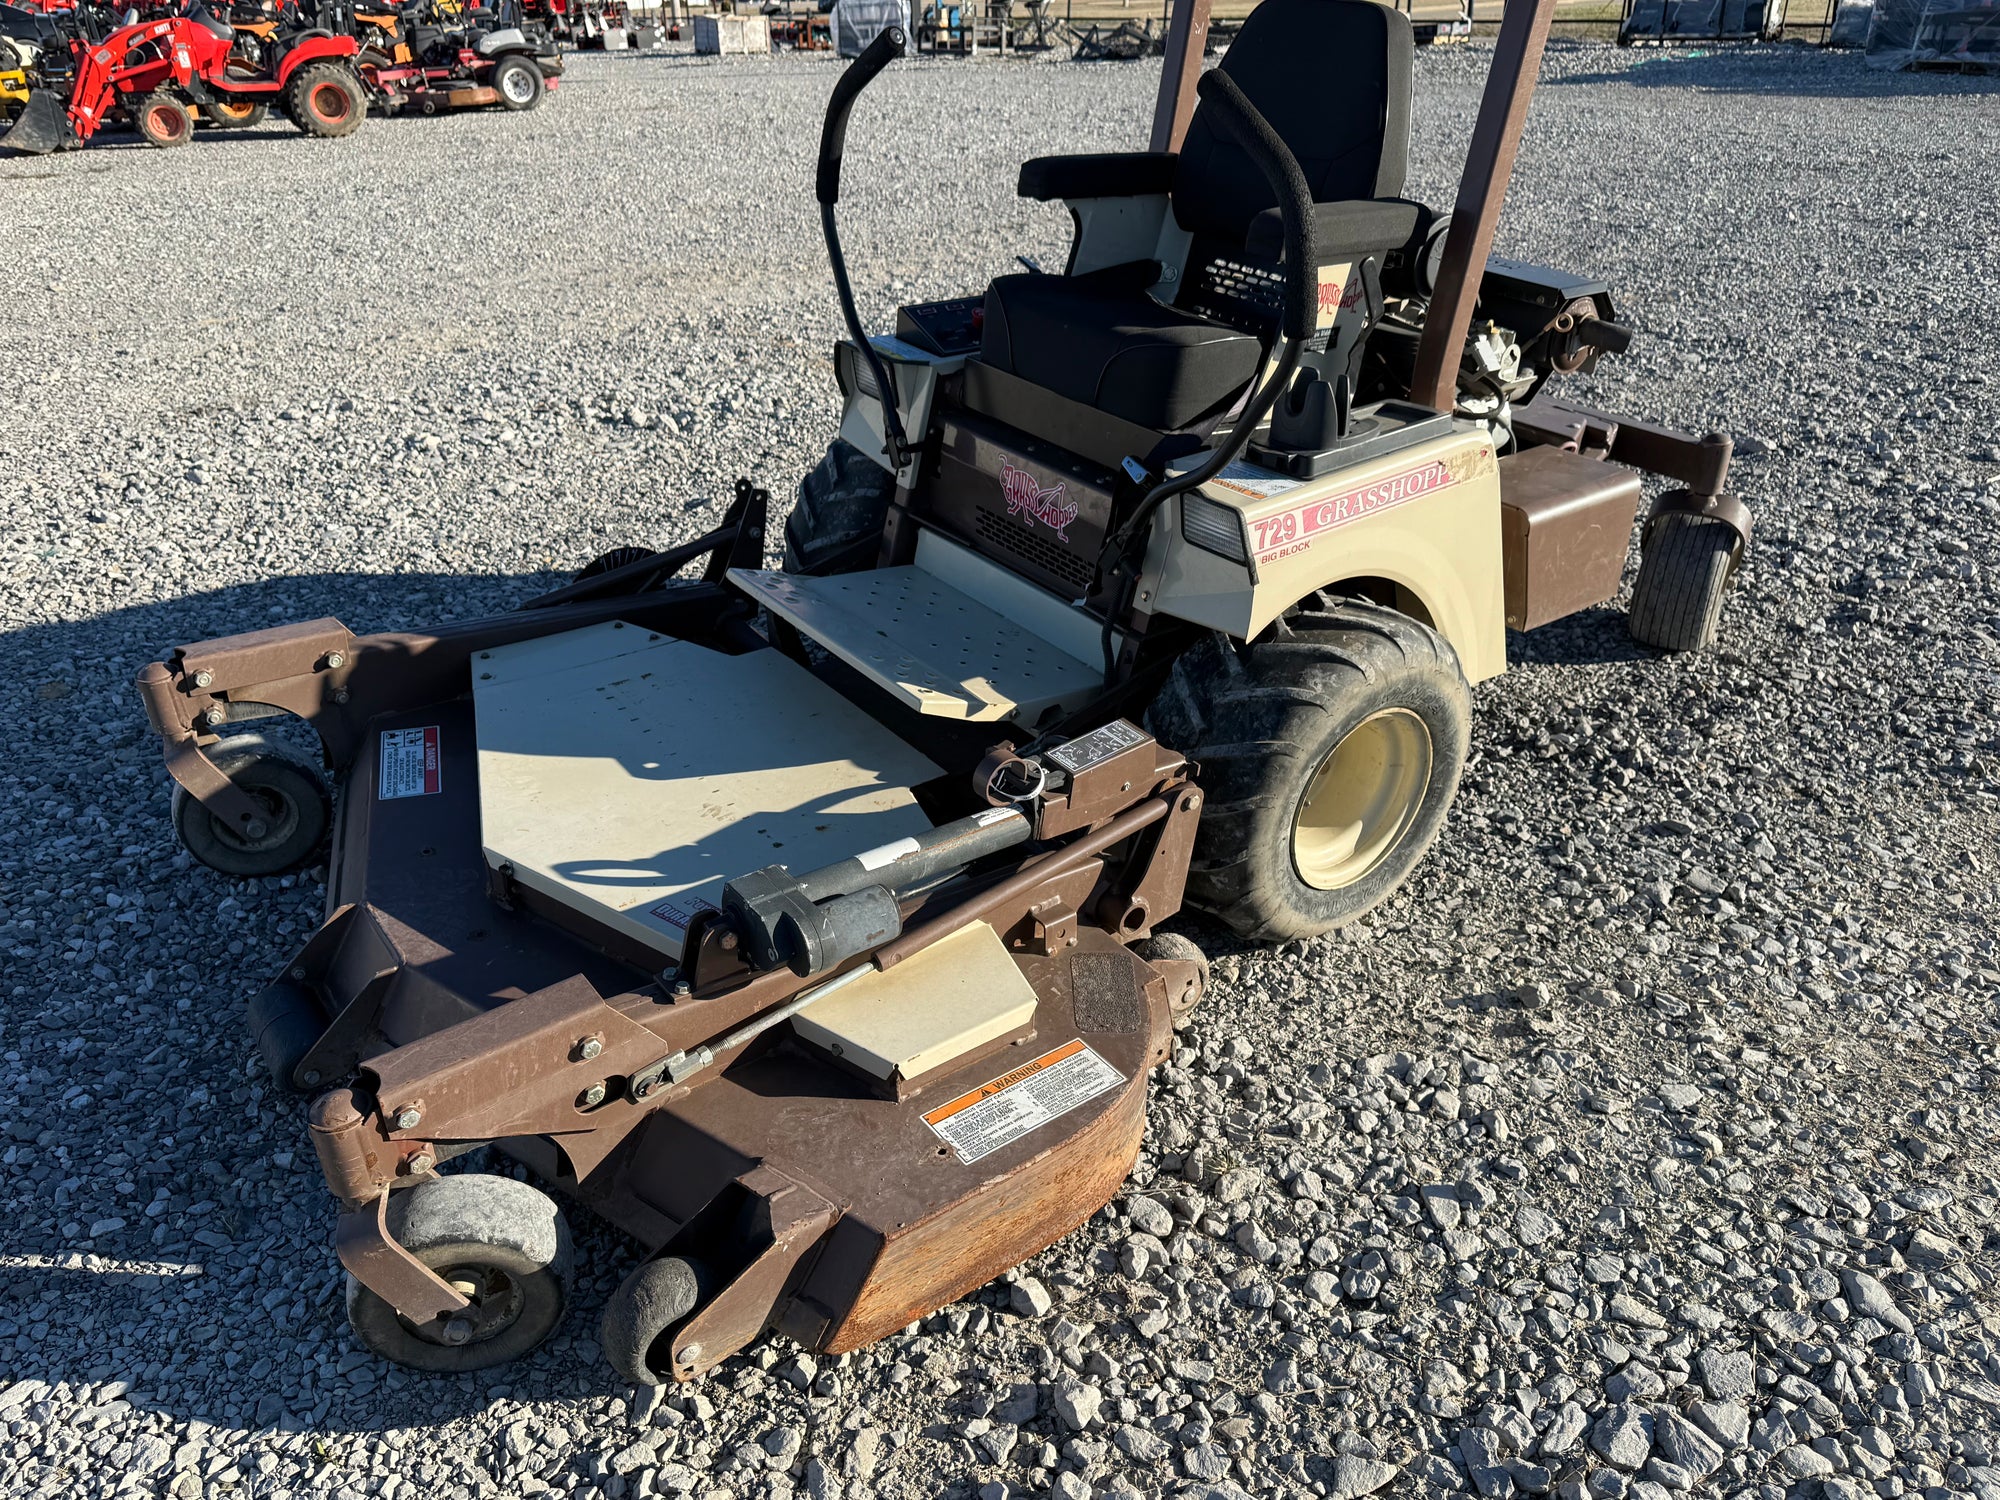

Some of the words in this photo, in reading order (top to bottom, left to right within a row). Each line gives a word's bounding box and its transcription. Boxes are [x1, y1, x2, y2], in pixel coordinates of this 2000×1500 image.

[1254, 513, 1297, 550] 729
[1316, 465, 1454, 527] GRASSHOPP
[1261, 551, 1279, 564] BIG
[1280, 540, 1310, 558] BLOCK
[993, 1061, 1042, 1090] WARNING
[953, 1106, 976, 1120] SERIOUS
[975, 1098, 993, 1108] INJURY
[1004, 1082, 1023, 1094] RESULT
[1022, 1075, 1038, 1084] FROM
